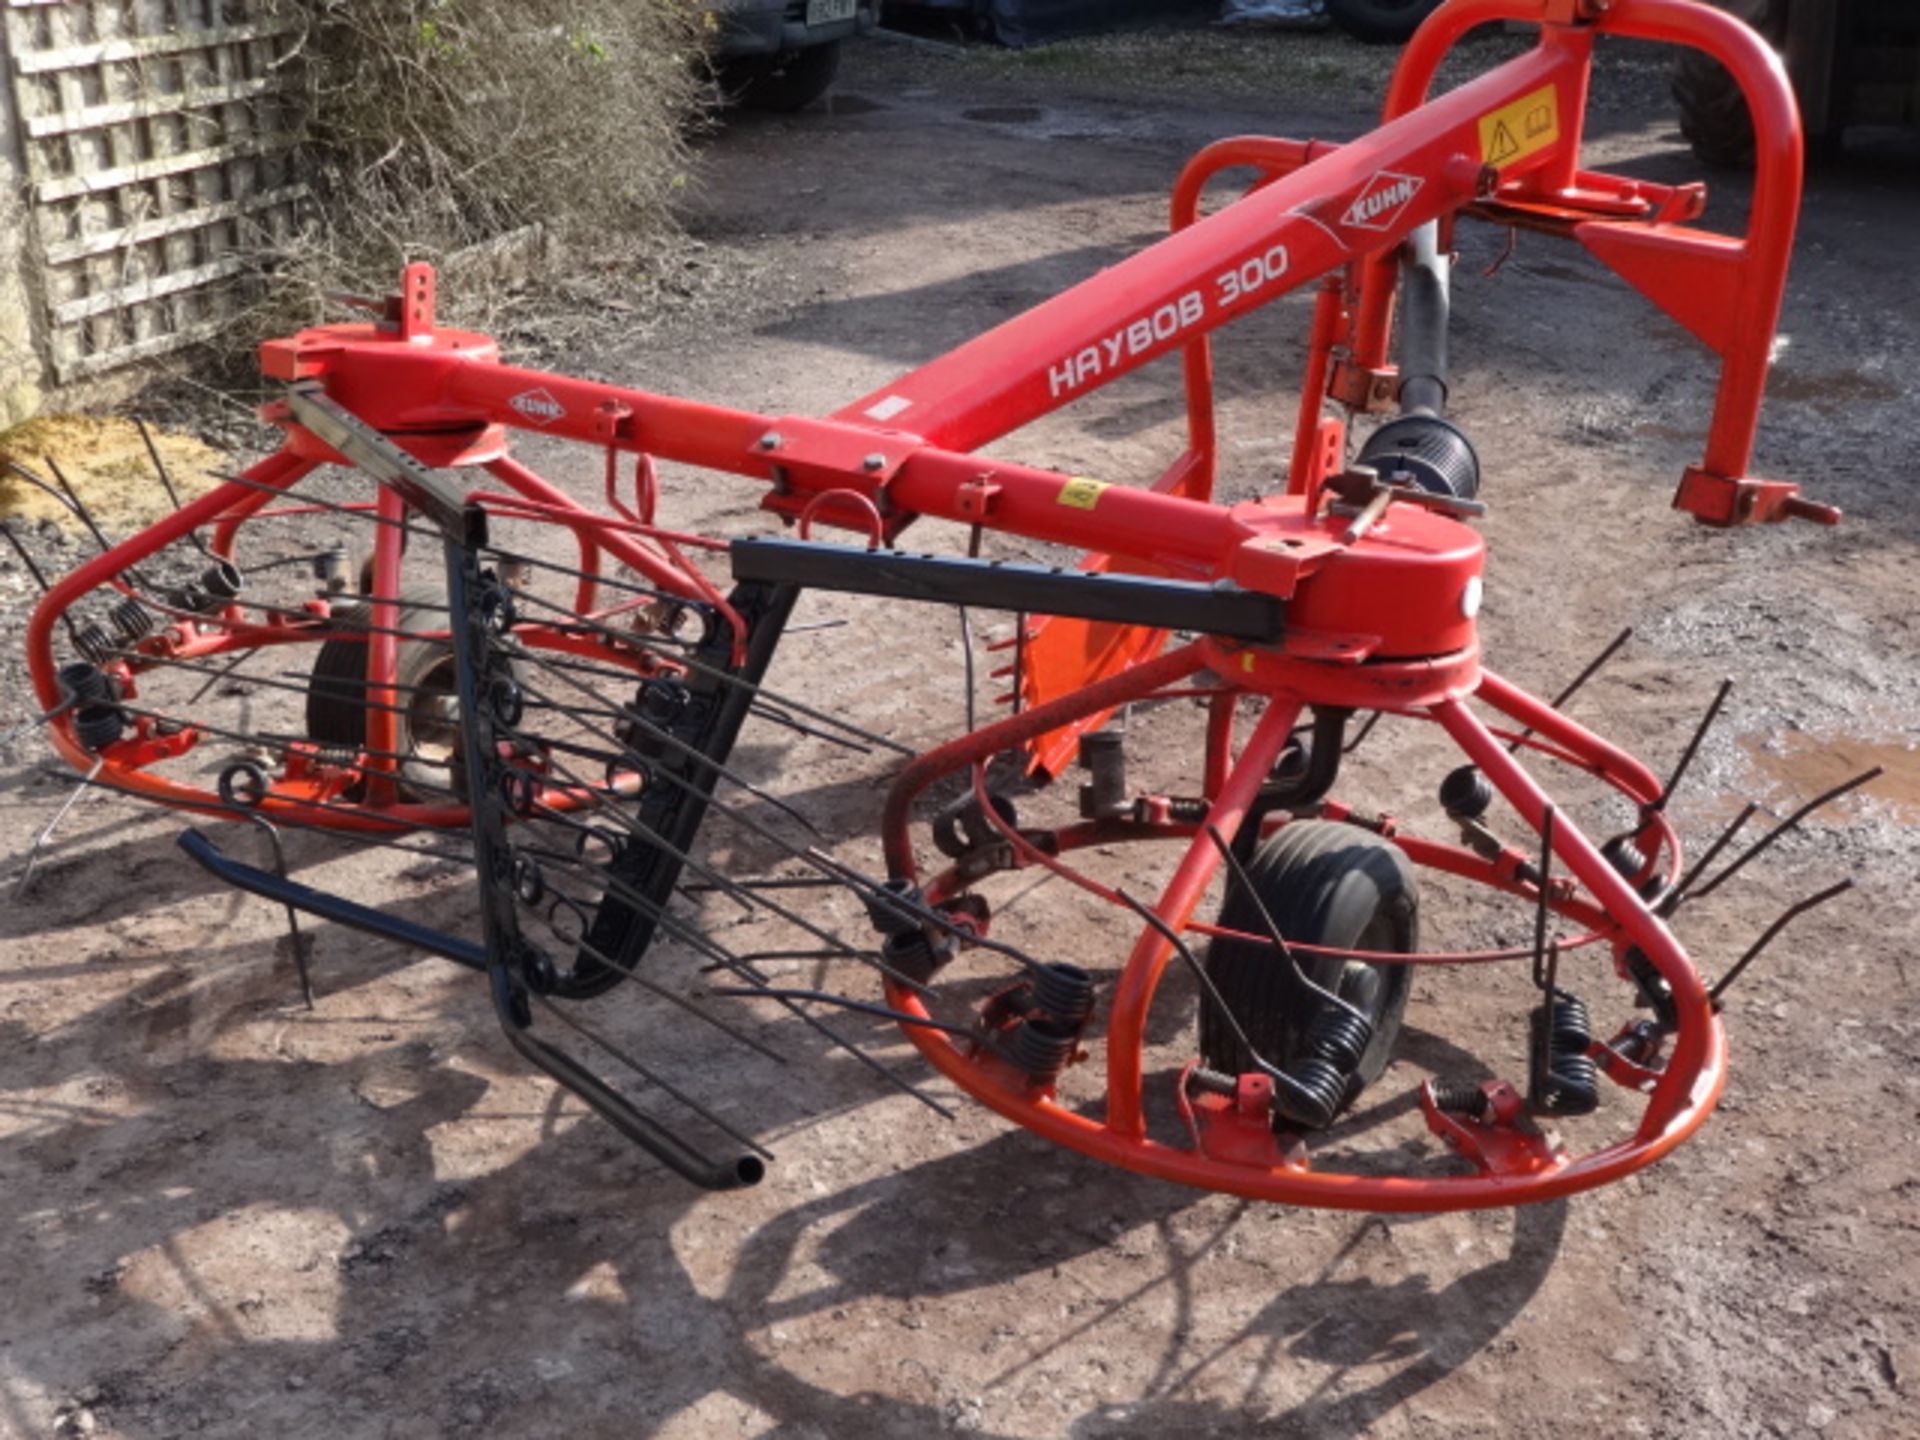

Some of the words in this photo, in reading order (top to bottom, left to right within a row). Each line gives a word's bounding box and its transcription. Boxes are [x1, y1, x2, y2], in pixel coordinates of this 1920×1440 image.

[1351, 179, 1412, 225] KUHN
[1049, 291, 1204, 397] HAYBOB
[1217, 245, 1288, 306] 300
